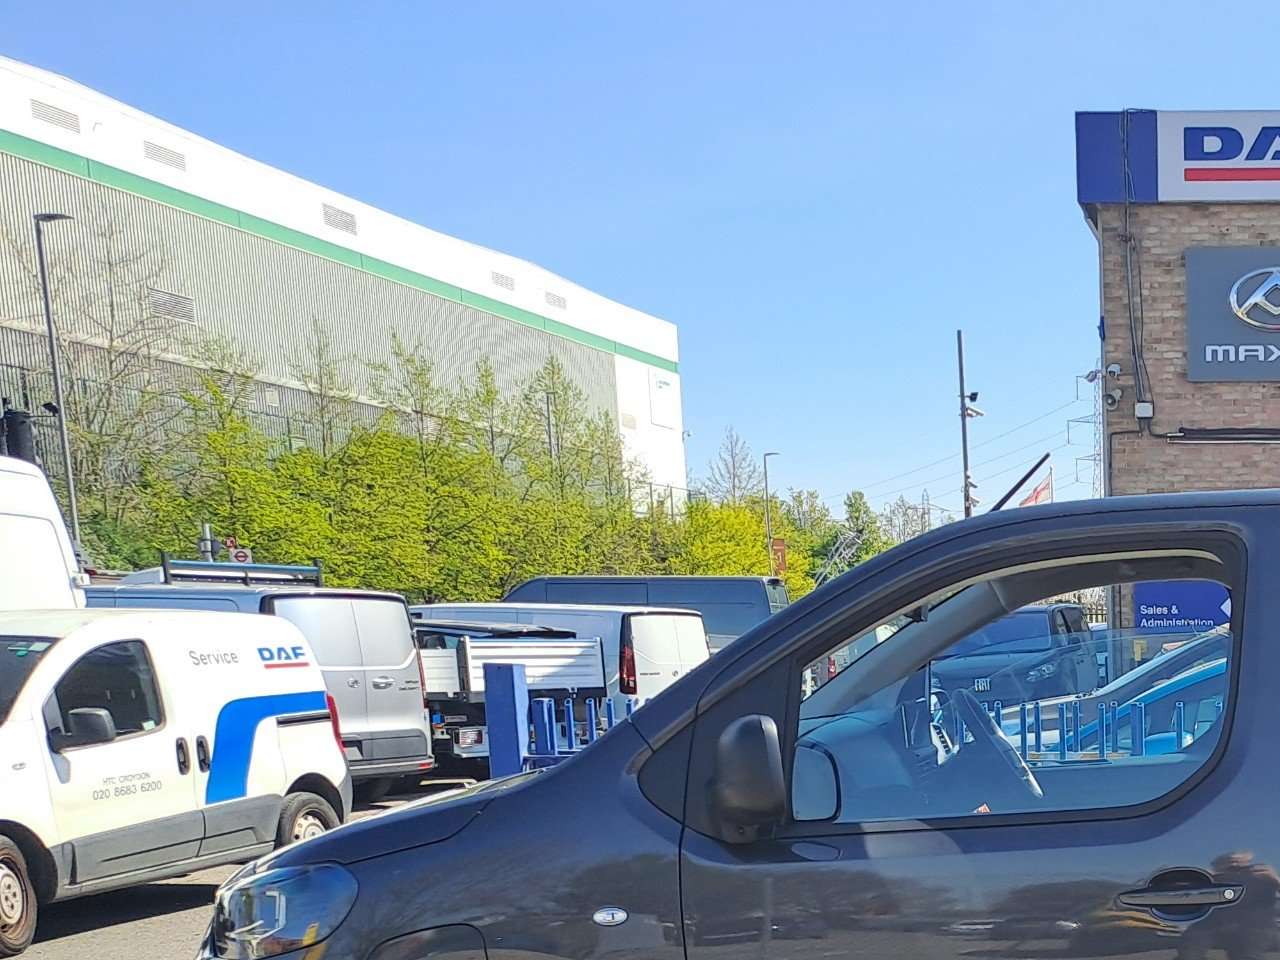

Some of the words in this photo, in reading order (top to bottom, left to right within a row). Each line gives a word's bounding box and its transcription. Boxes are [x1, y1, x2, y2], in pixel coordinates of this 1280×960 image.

[1140, 604, 1168, 615] Sales
[1171, 604, 1179, 615] &
[1140, 618, 1214, 628] Administration
[188, 650, 239, 666] Service
[257, 646, 305, 661] DAF
[92, 788, 111, 801] 020
[113, 784, 138, 797] 8683
[140, 780, 163, 793] 6200
